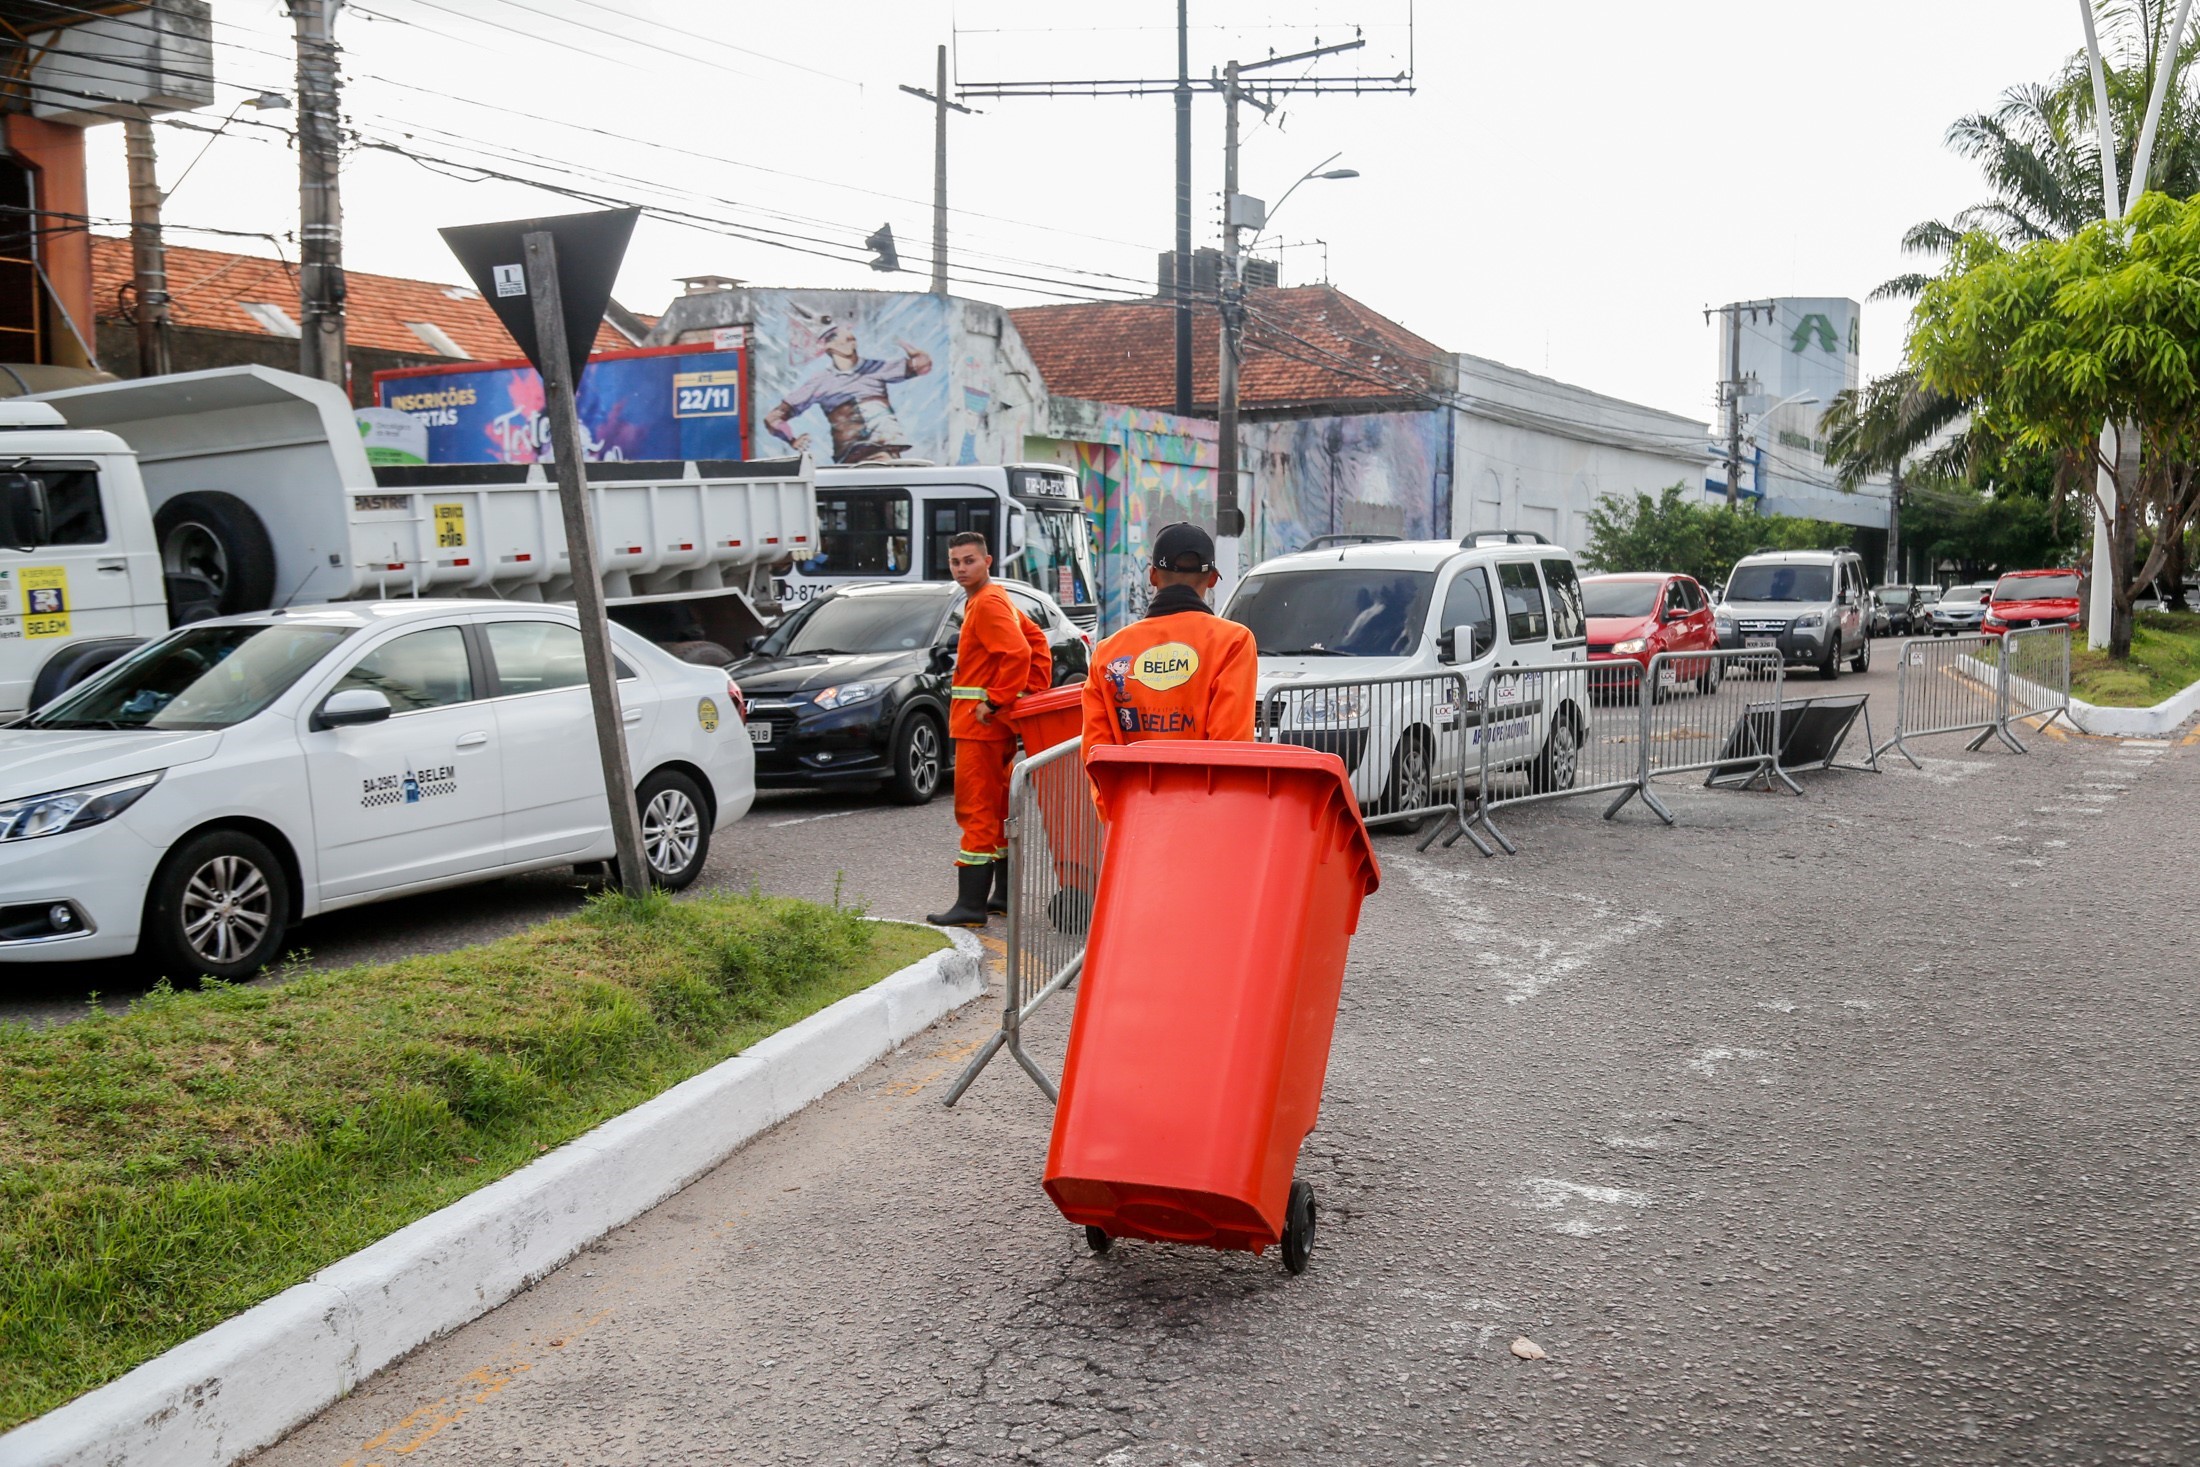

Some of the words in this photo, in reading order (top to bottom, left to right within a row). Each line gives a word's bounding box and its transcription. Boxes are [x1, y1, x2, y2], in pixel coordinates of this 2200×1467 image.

[392, 387, 477, 411] INSCRIÇÕES
[679, 388, 730, 411] 22/11
[411, 410, 458, 427] ERTAS
[440, 533, 463, 546] PMB
[1143, 657, 1189, 674] BELÉM
[1498, 689, 1515, 697] LOC
[1434, 706, 1452, 715] LOC
[705, 721, 715, 730] 26
[1141, 711, 1196, 733] BELÉM
[363, 774, 398, 793] BA-2963
[417, 765, 455, 784] BELÉM
